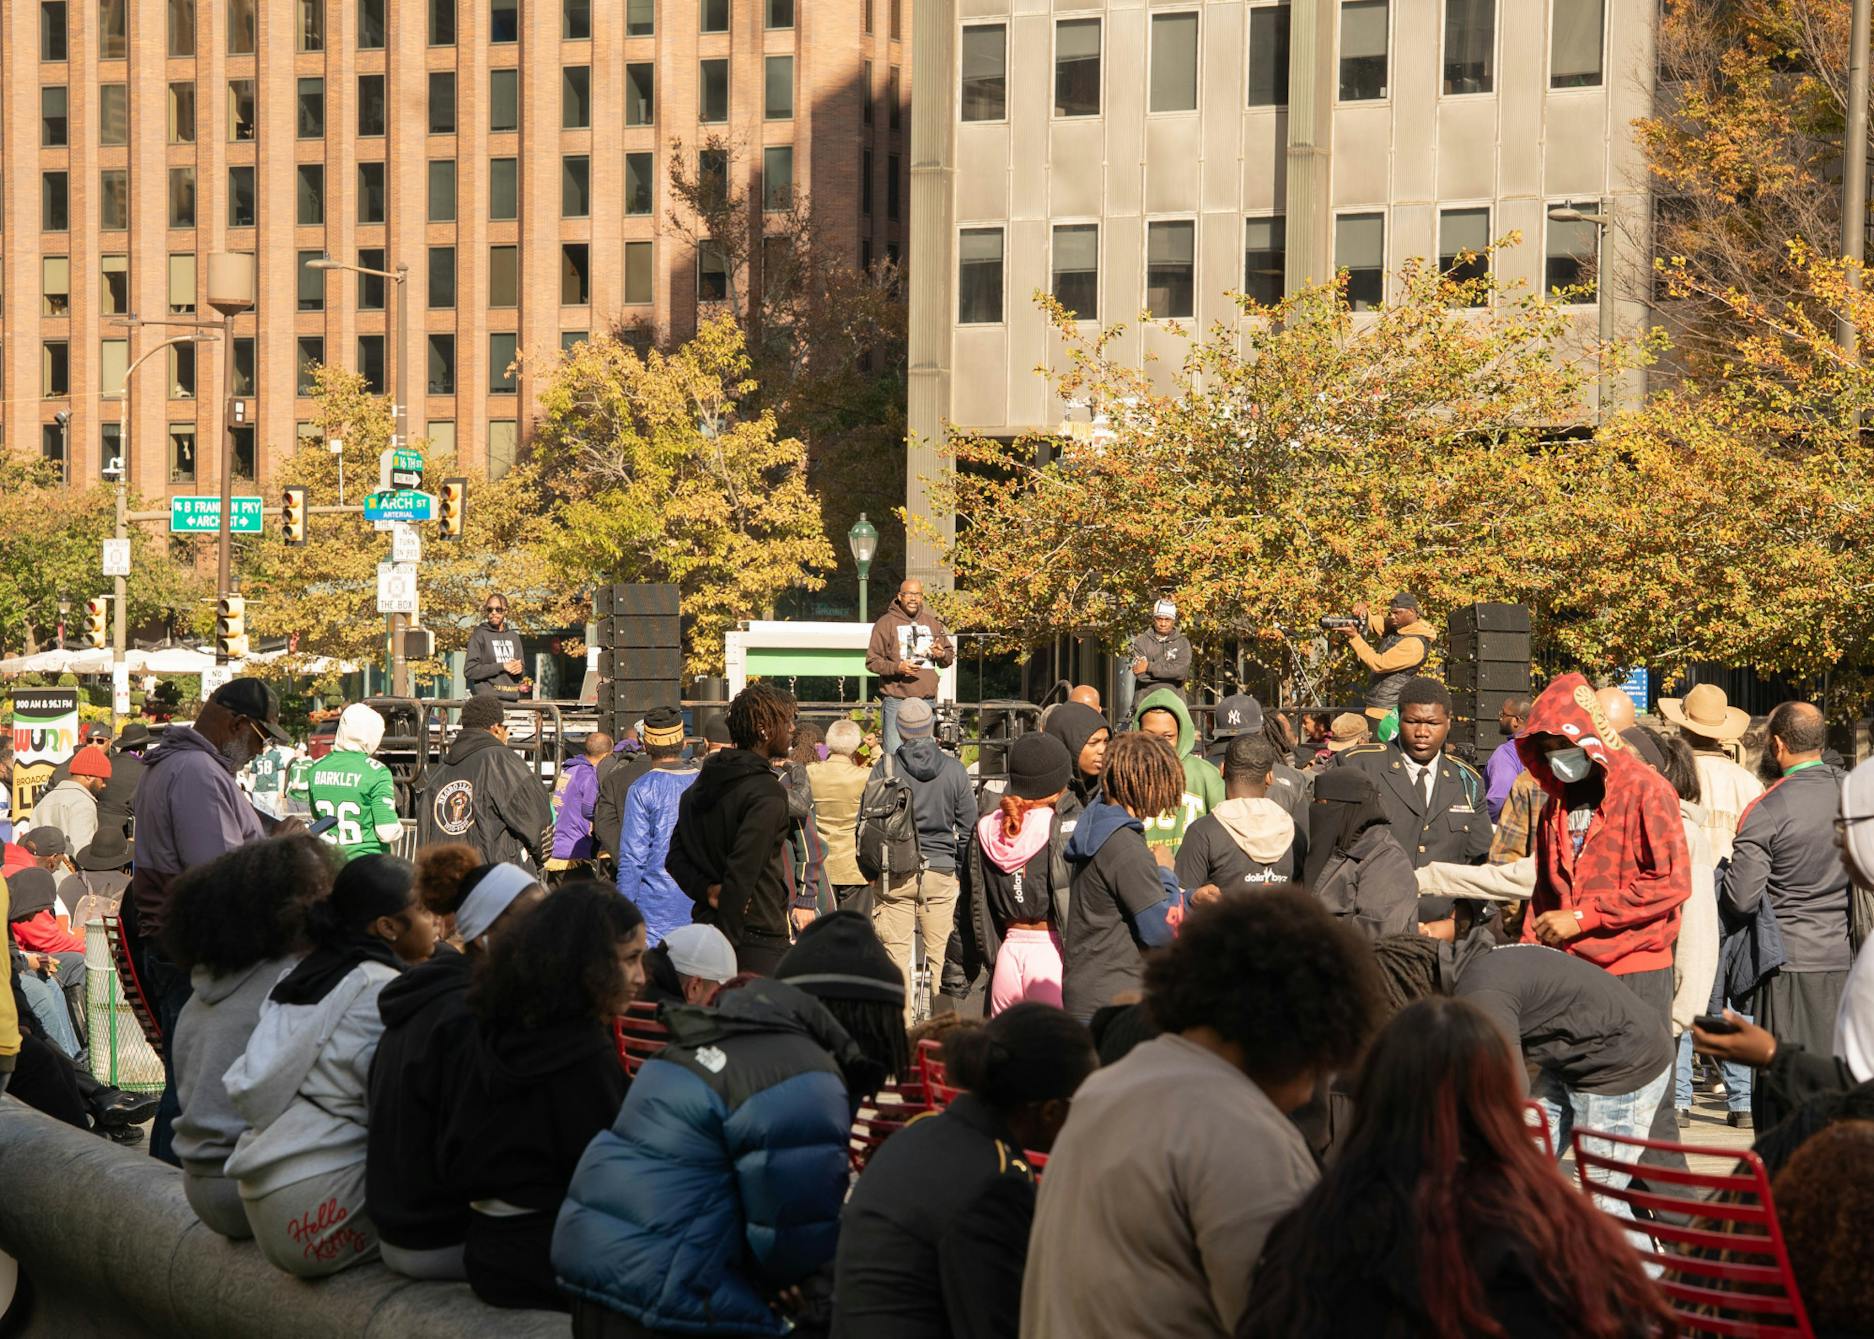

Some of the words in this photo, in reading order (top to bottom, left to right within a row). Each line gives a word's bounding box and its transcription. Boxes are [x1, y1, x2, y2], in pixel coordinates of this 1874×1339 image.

[184, 501, 191, 513] B
[242, 502, 260, 514] PKY
[380, 497, 413, 510] ARCH
[416, 499, 426, 508] ST
[380, 600, 393, 609] THE
[397, 600, 413, 609] BOX
[16, 700, 29, 709] 900
[30, 700, 41, 708] AM
[41, 700, 49, 708] &
[62, 699, 73, 708] FM
[256, 759, 273, 776] 58
[314, 770, 363, 788] BARKLEY
[287, 1198, 348, 1243] Hello
